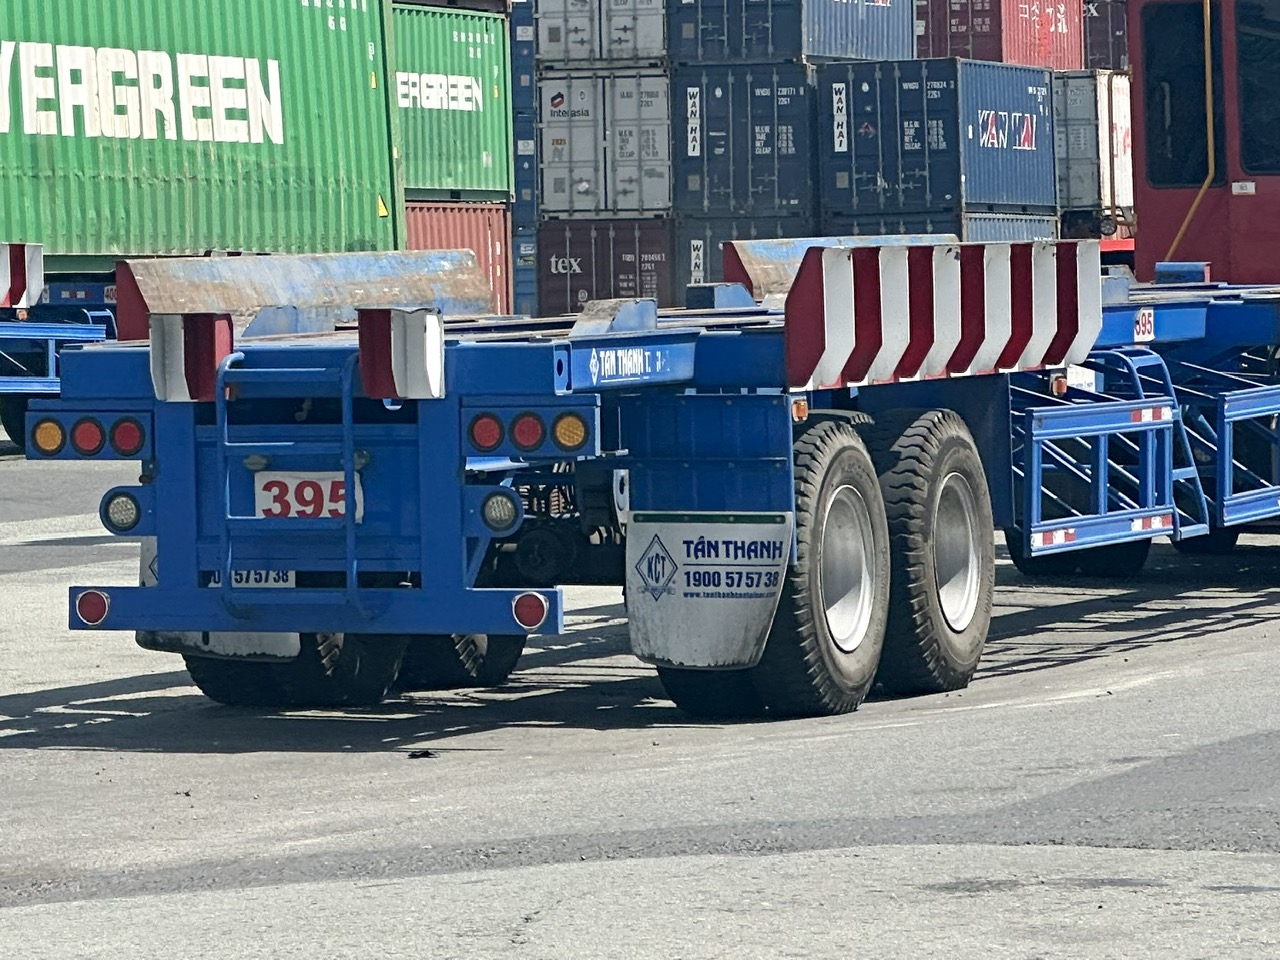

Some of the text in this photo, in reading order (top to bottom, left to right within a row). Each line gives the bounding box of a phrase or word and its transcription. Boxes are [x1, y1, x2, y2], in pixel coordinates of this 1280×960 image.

[550, 108, 589, 118] Interasia
[688, 92, 699, 152] WAN HAI
[833, 86, 845, 148] WAN HAI
[549, 252, 582, 274] tex
[692, 243, 702, 270] WAN
[262, 480, 347, 518] 395
[683, 536, 783, 561] TÂN THANH
[647, 552, 666, 584] KCT
[684, 571, 779, 588] 1900 57 57 38
